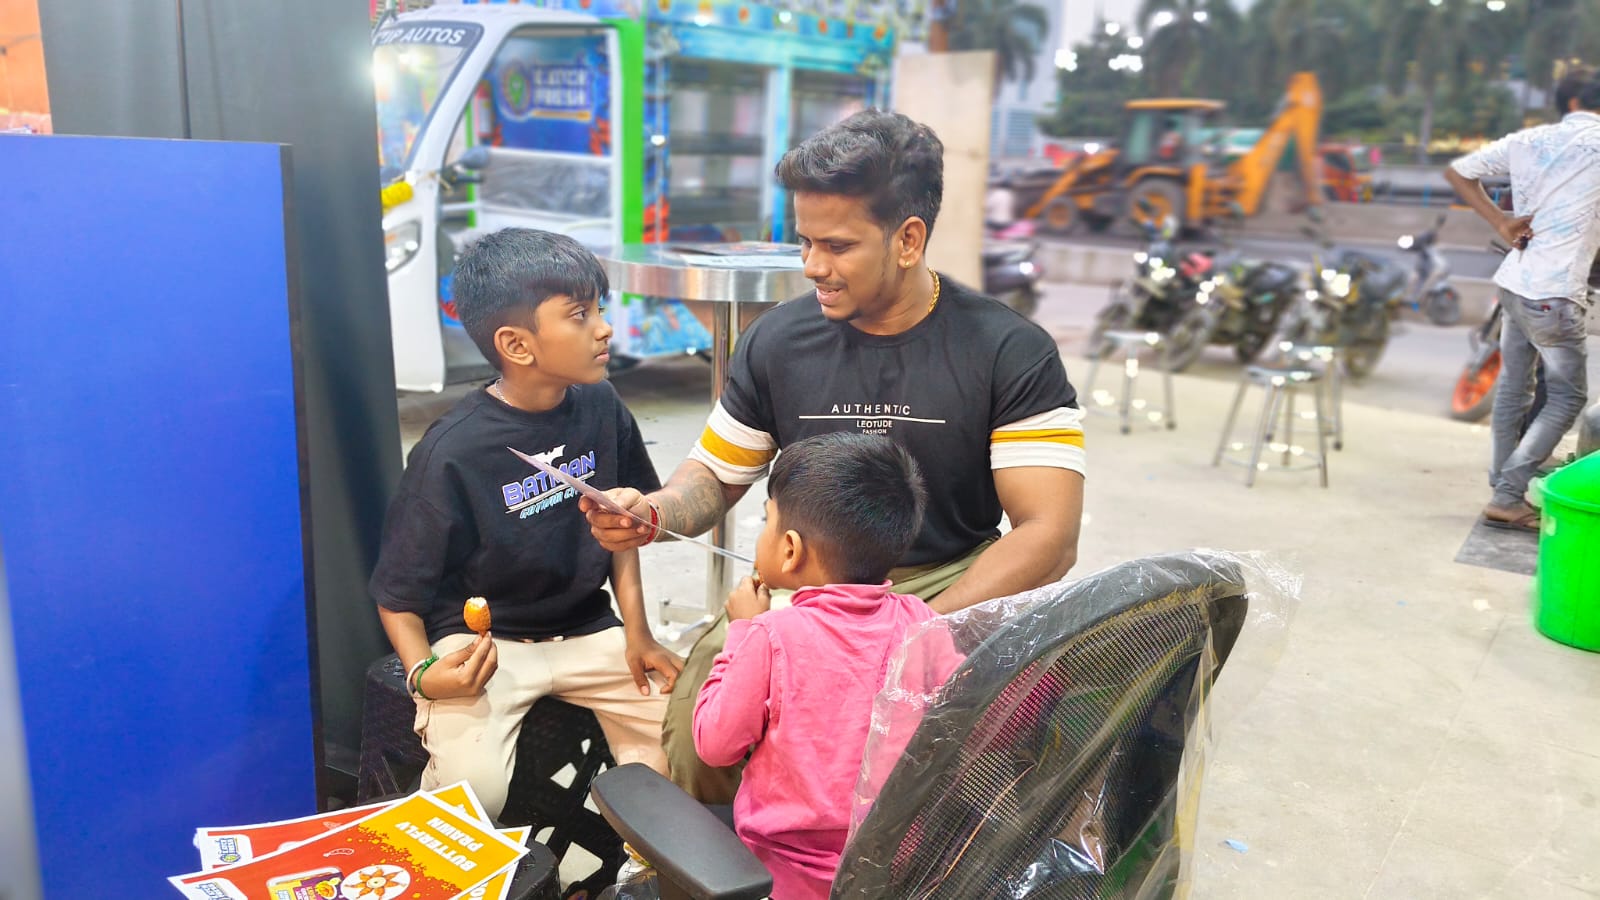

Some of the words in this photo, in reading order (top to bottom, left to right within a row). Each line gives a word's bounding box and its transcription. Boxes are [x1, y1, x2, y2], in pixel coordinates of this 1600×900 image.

[400, 26, 466, 44] AUTOS
[831, 403, 911, 416] AUTHENTIC
[856, 419, 893, 428] LEOTUDE
[426, 816, 485, 852] PRAWN
[394, 821, 478, 872] BUTTERFLY
